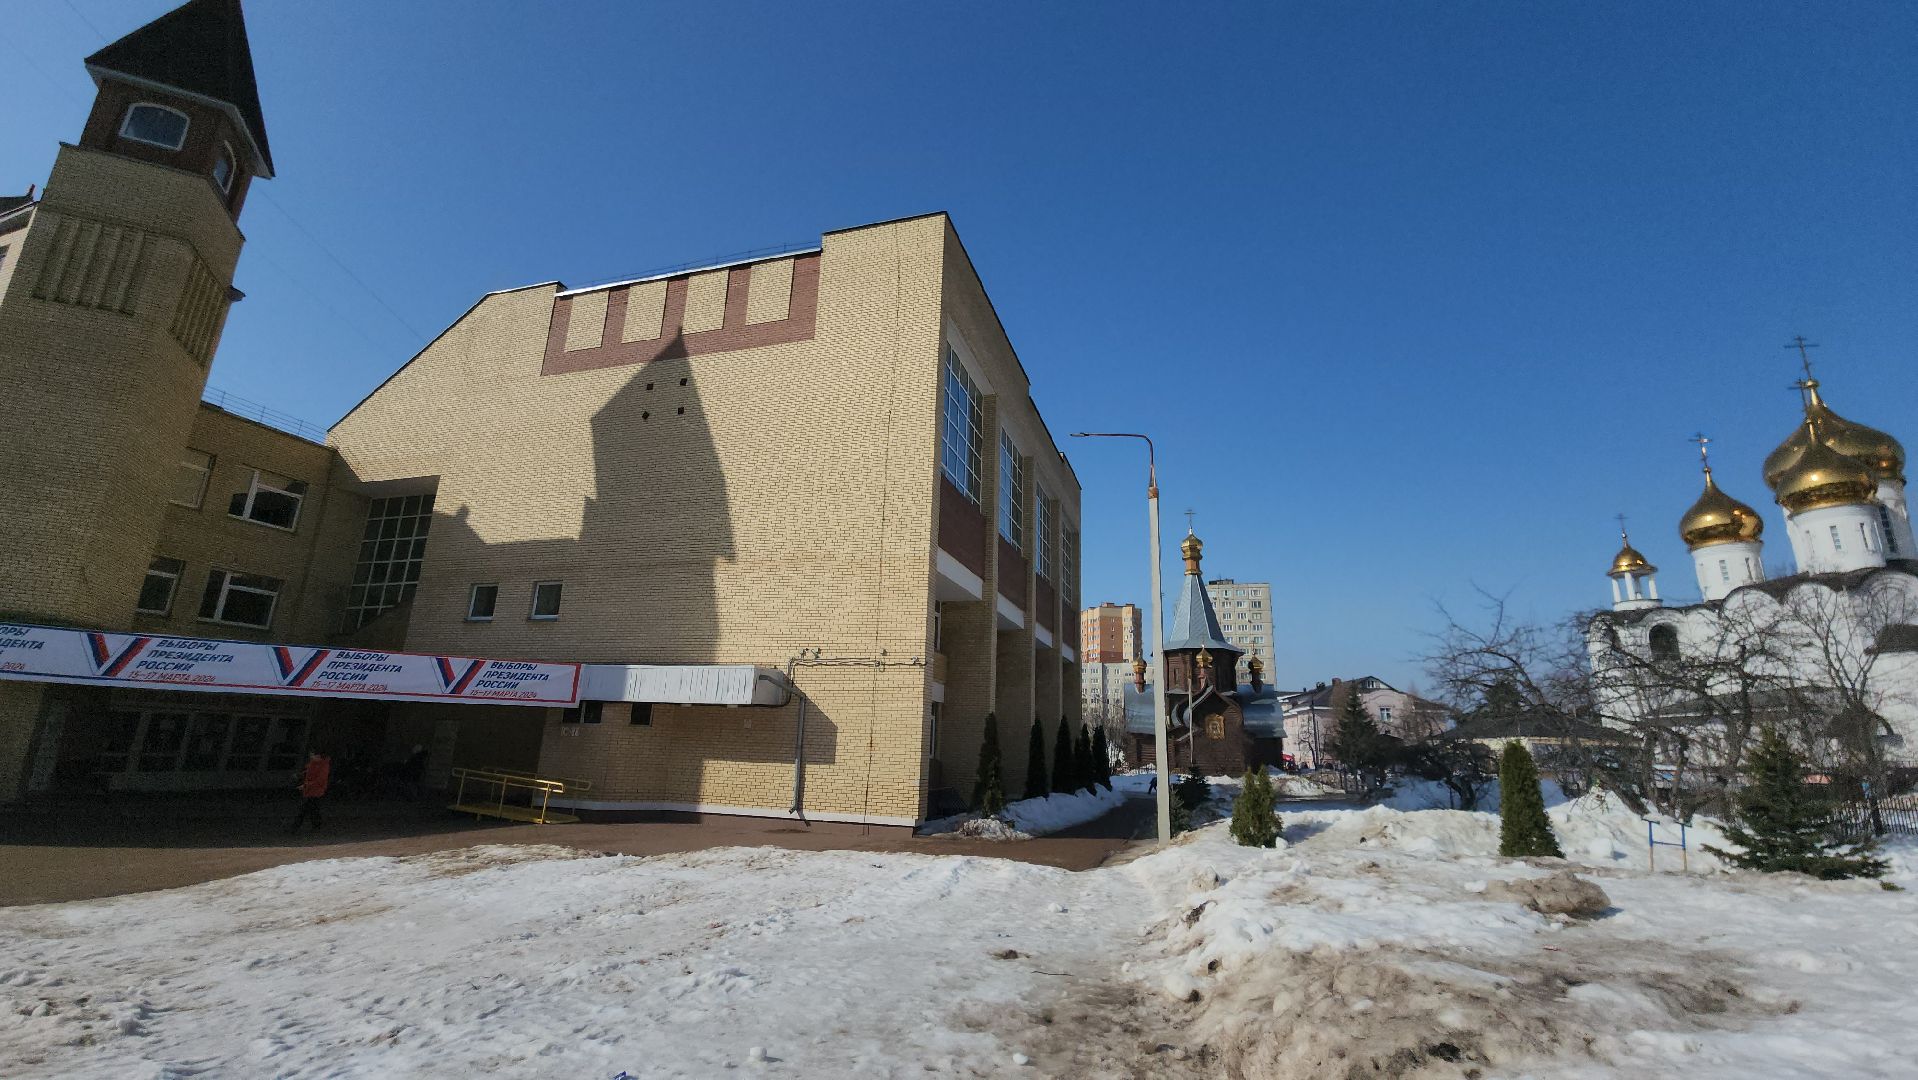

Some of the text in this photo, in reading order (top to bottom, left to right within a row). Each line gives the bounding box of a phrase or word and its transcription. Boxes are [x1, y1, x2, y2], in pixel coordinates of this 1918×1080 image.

[156, 640, 220, 651] ВЫБОРЫ
[147, 649, 234, 663] ПРЕЗИДЕНТА
[336, 651, 390, 661] ВЫБОРЫ
[136, 660, 195, 671] РОССИИ
[326, 661, 403, 673] ПРЕЗИДЕНТА
[490, 661, 538, 671] ВЫБОРЫ
[157, 672, 192, 681] МАРТА
[192, 674, 216, 683] 2024
[317, 671, 369, 681] РОССИИ
[483, 670, 550, 681] ПРЕЗИДЕНТА
[337, 682, 366, 690] МАРТА
[475, 680, 520, 690] РОССИИ
[491, 690, 518, 698] МАРТА
